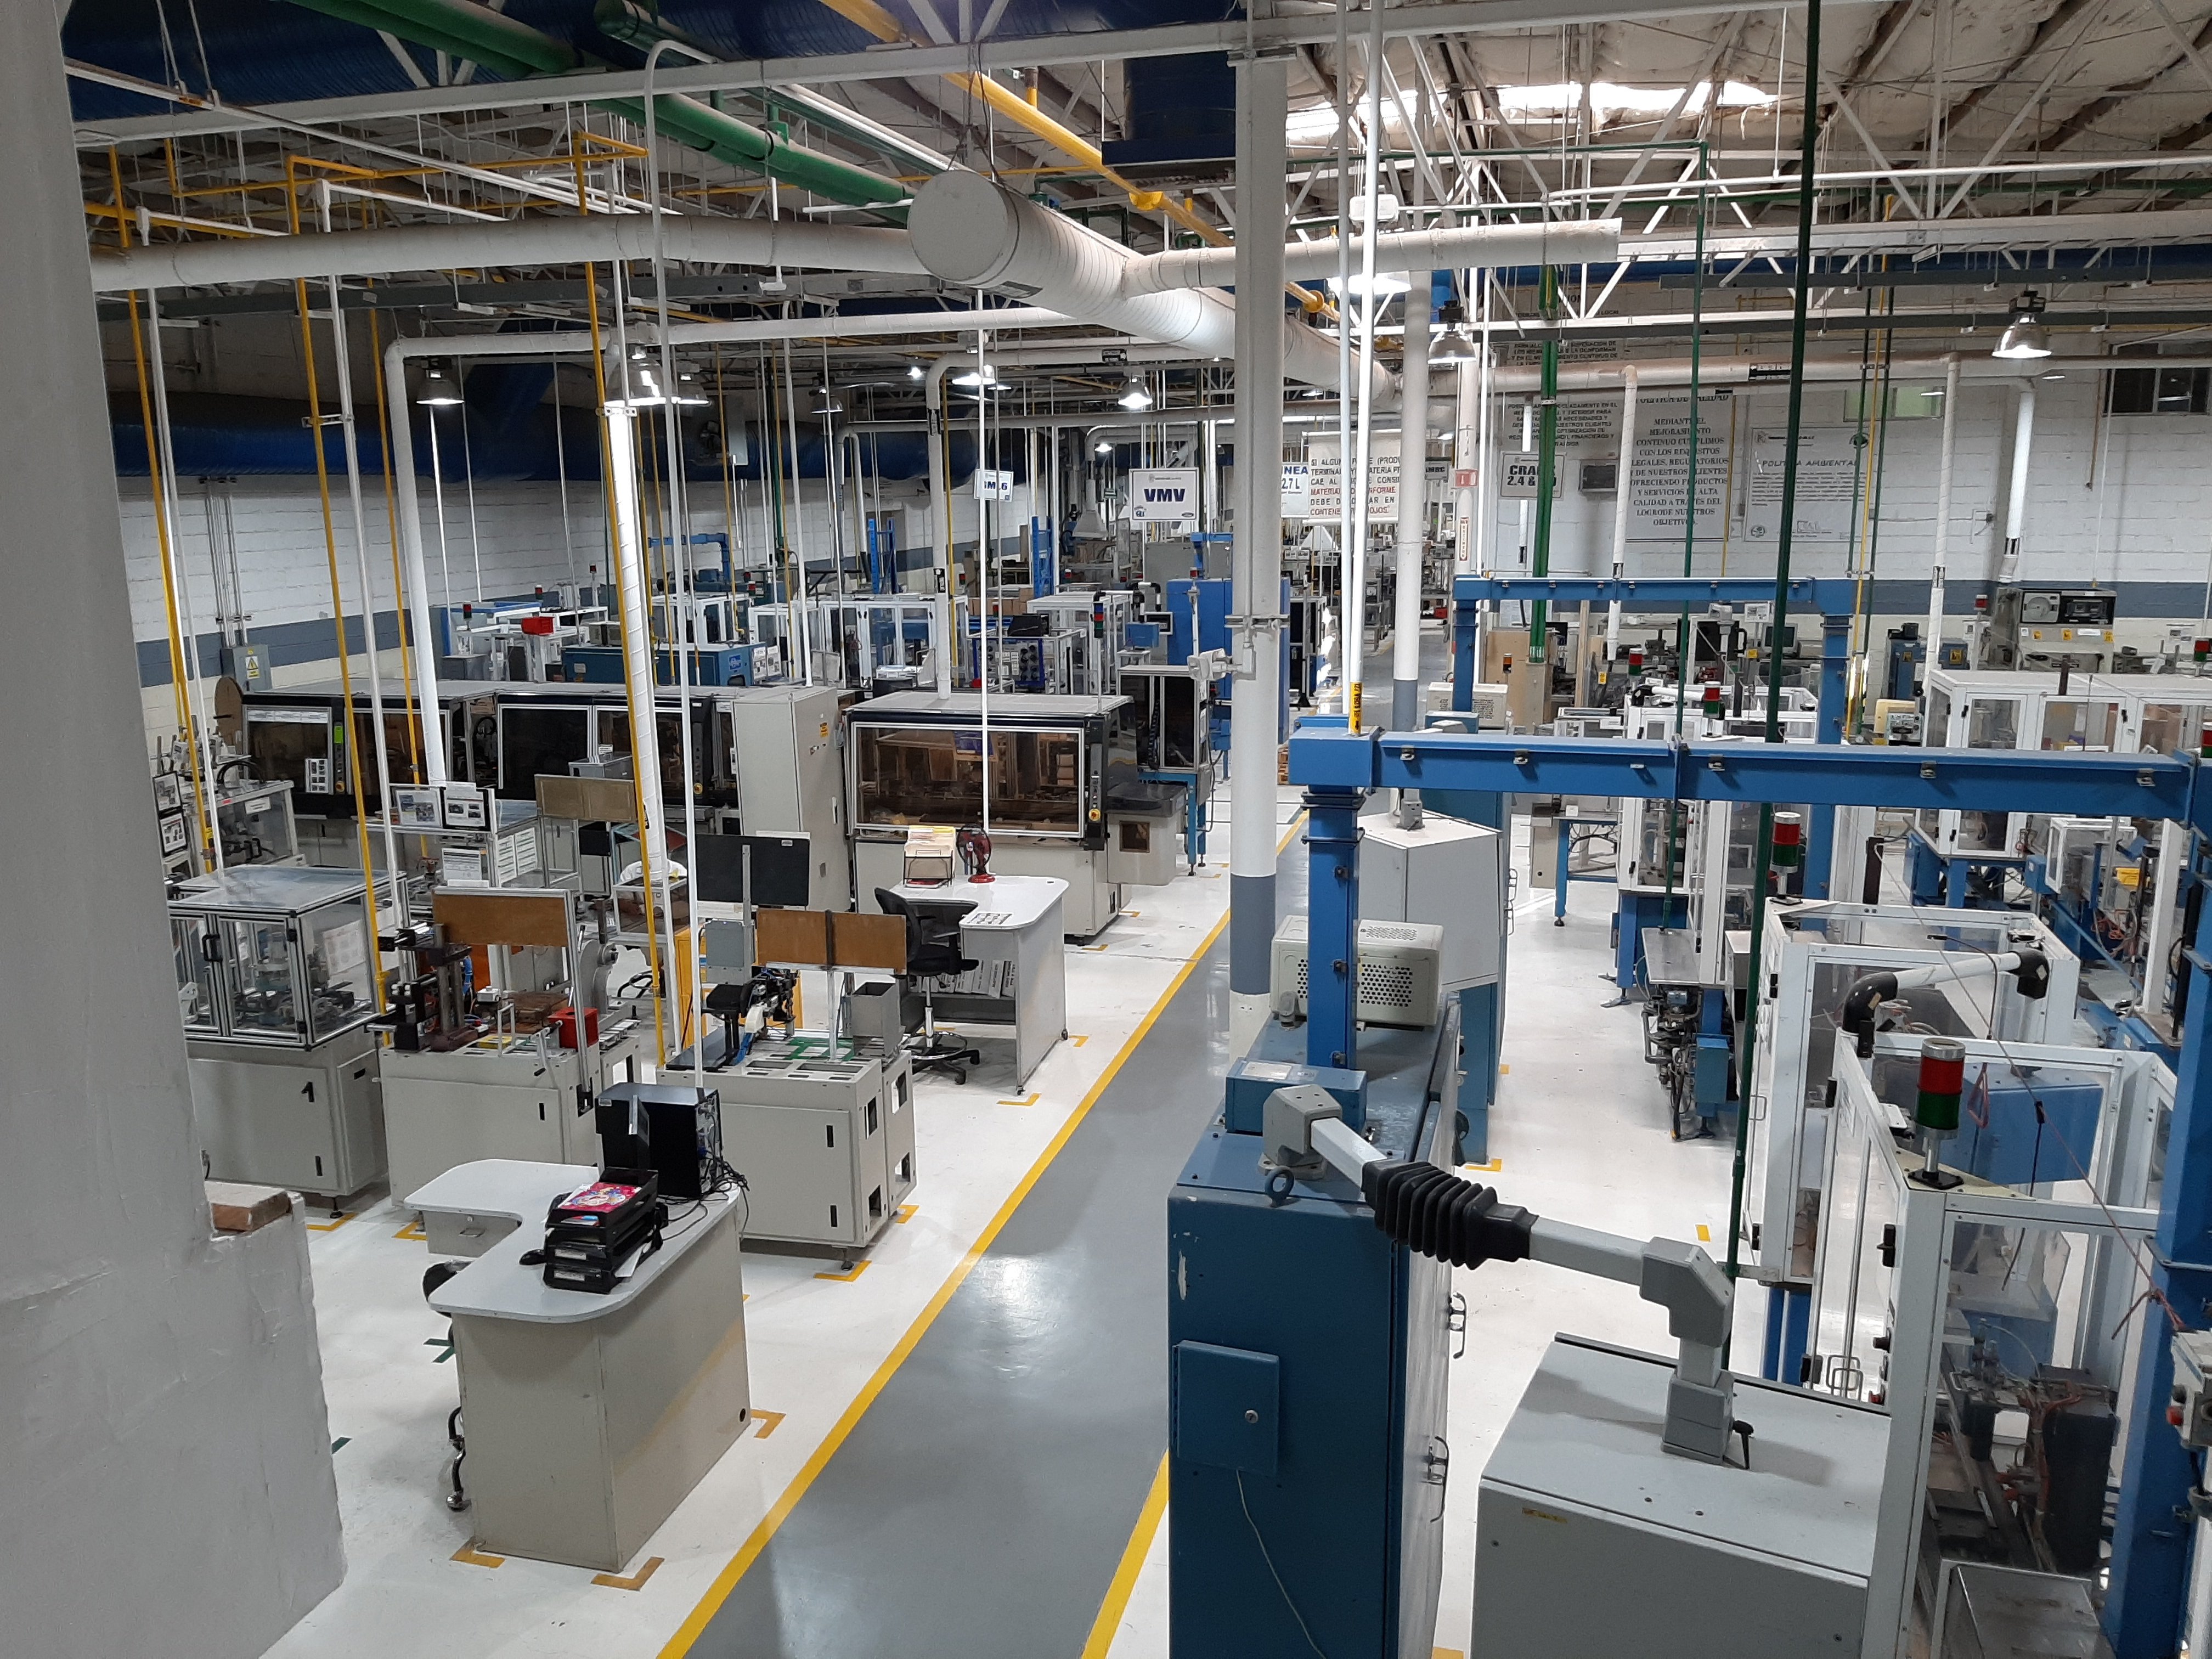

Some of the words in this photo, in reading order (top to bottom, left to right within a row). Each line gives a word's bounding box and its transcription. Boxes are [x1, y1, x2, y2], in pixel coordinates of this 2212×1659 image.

[1649, 427, 1711, 436] MEJORAMINTO
[1636, 438, 1676, 447] CONTINUO
[1678, 437, 1724, 445] CULIMOS
[1674, 447, 1720, 456] REQSITOS
[1669, 457, 1729, 466] REGUATORIOS
[1647, 469, 1688, 477] NUESTROS
[1506, 476, 1525, 486] 2.4
[1143, 488, 1186, 503] VMV
[1706, 497, 1722, 505] DEL
